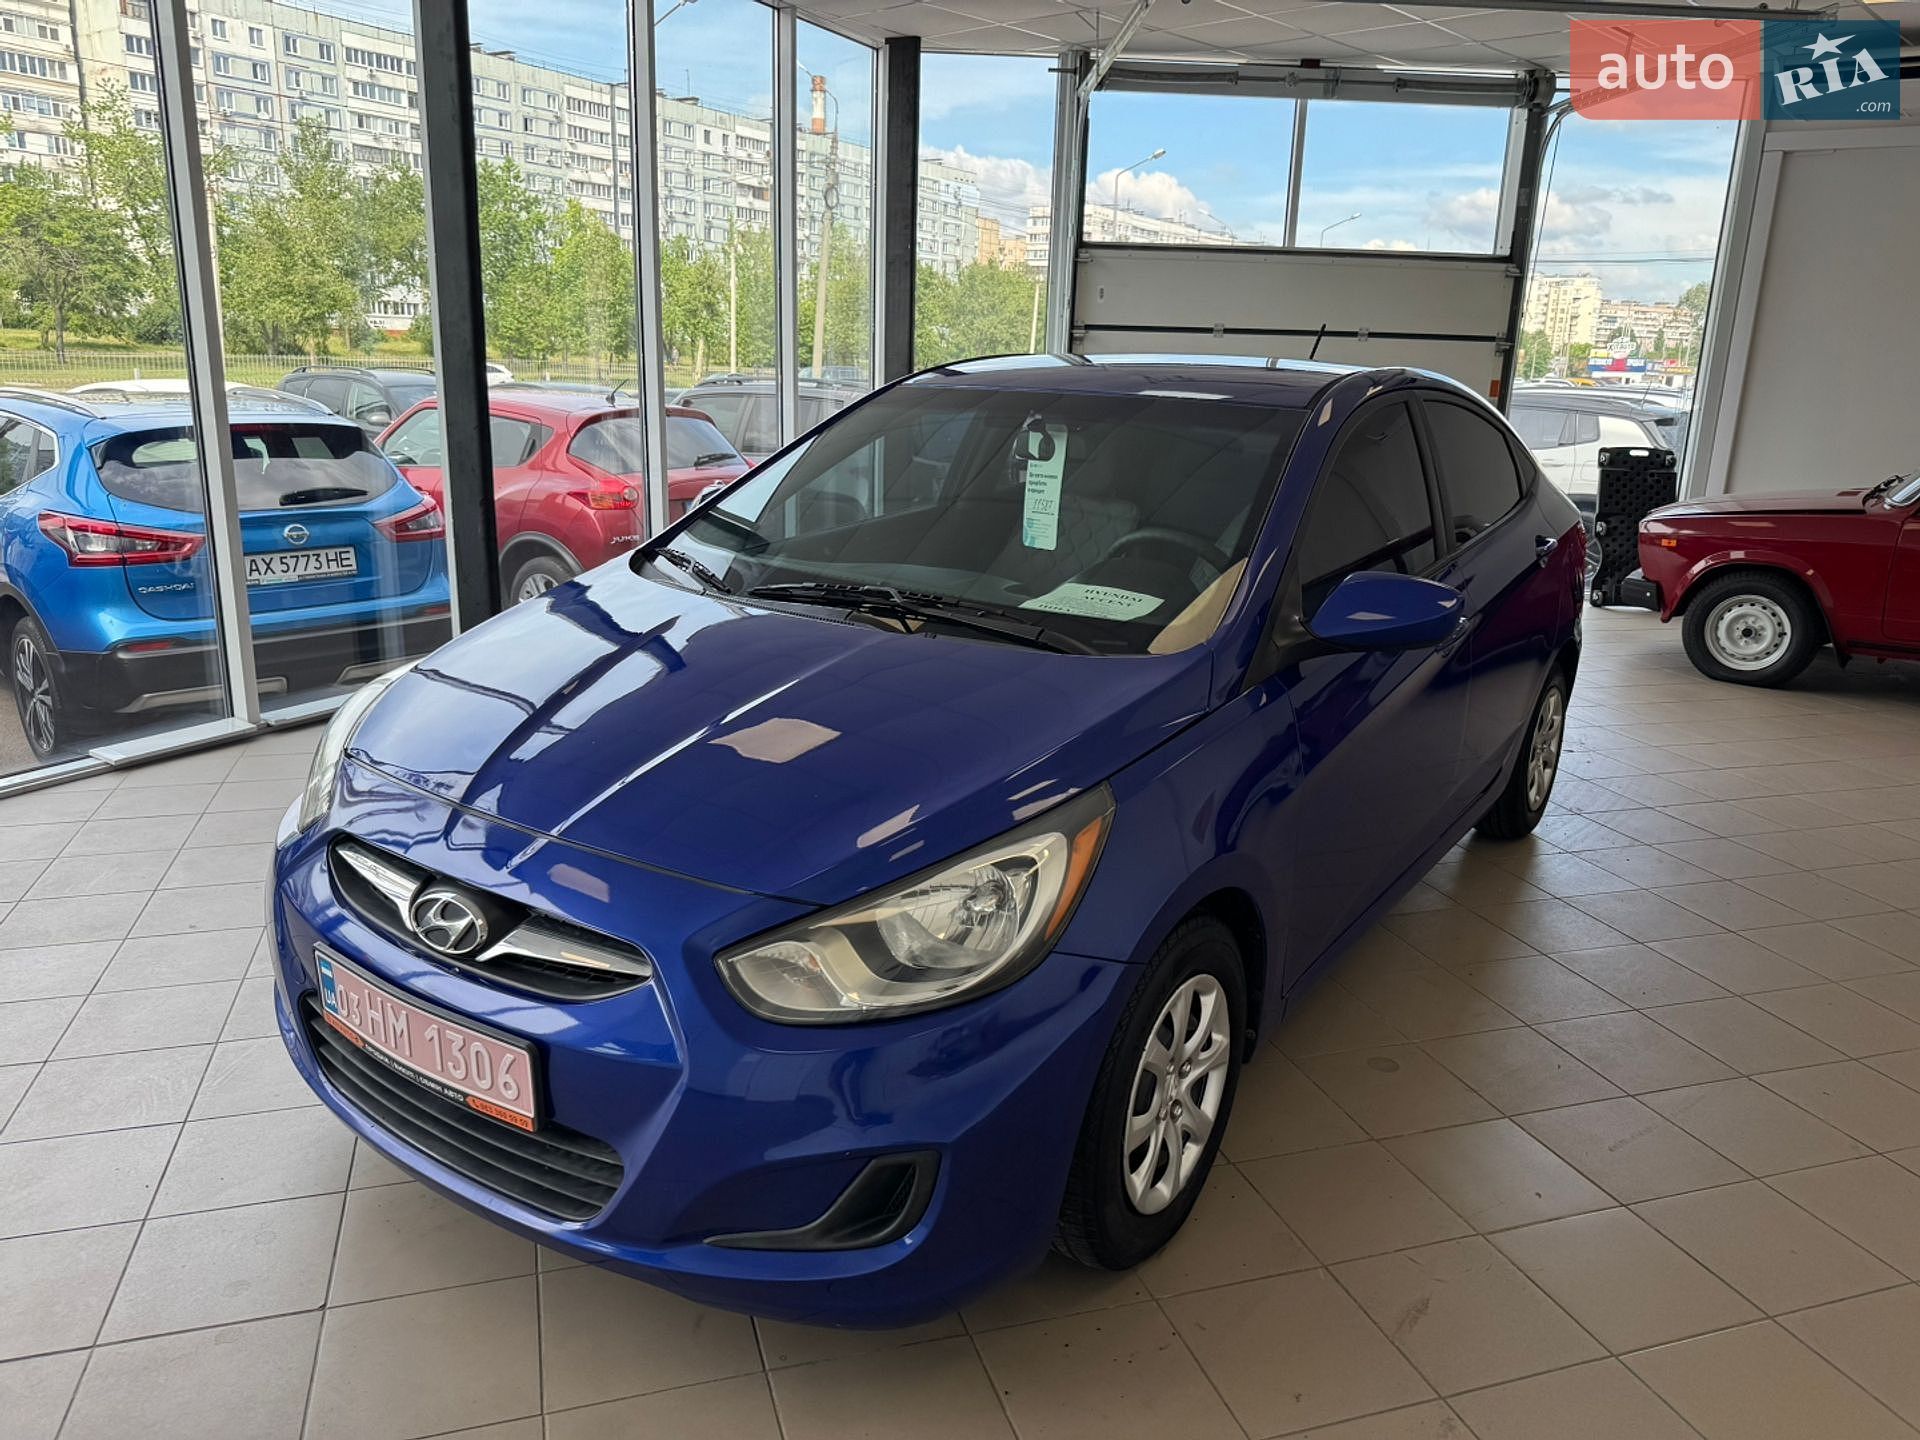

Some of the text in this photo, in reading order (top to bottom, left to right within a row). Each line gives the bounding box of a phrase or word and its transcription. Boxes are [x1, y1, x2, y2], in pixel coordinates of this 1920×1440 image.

[248, 556, 276, 577] AX
[280, 553, 324, 574] 5773
[325, 550, 353, 569] HE
[339, 984, 362, 1026] 03
[364, 989, 413, 1057] HM
[424, 1024, 520, 1101] 1306
